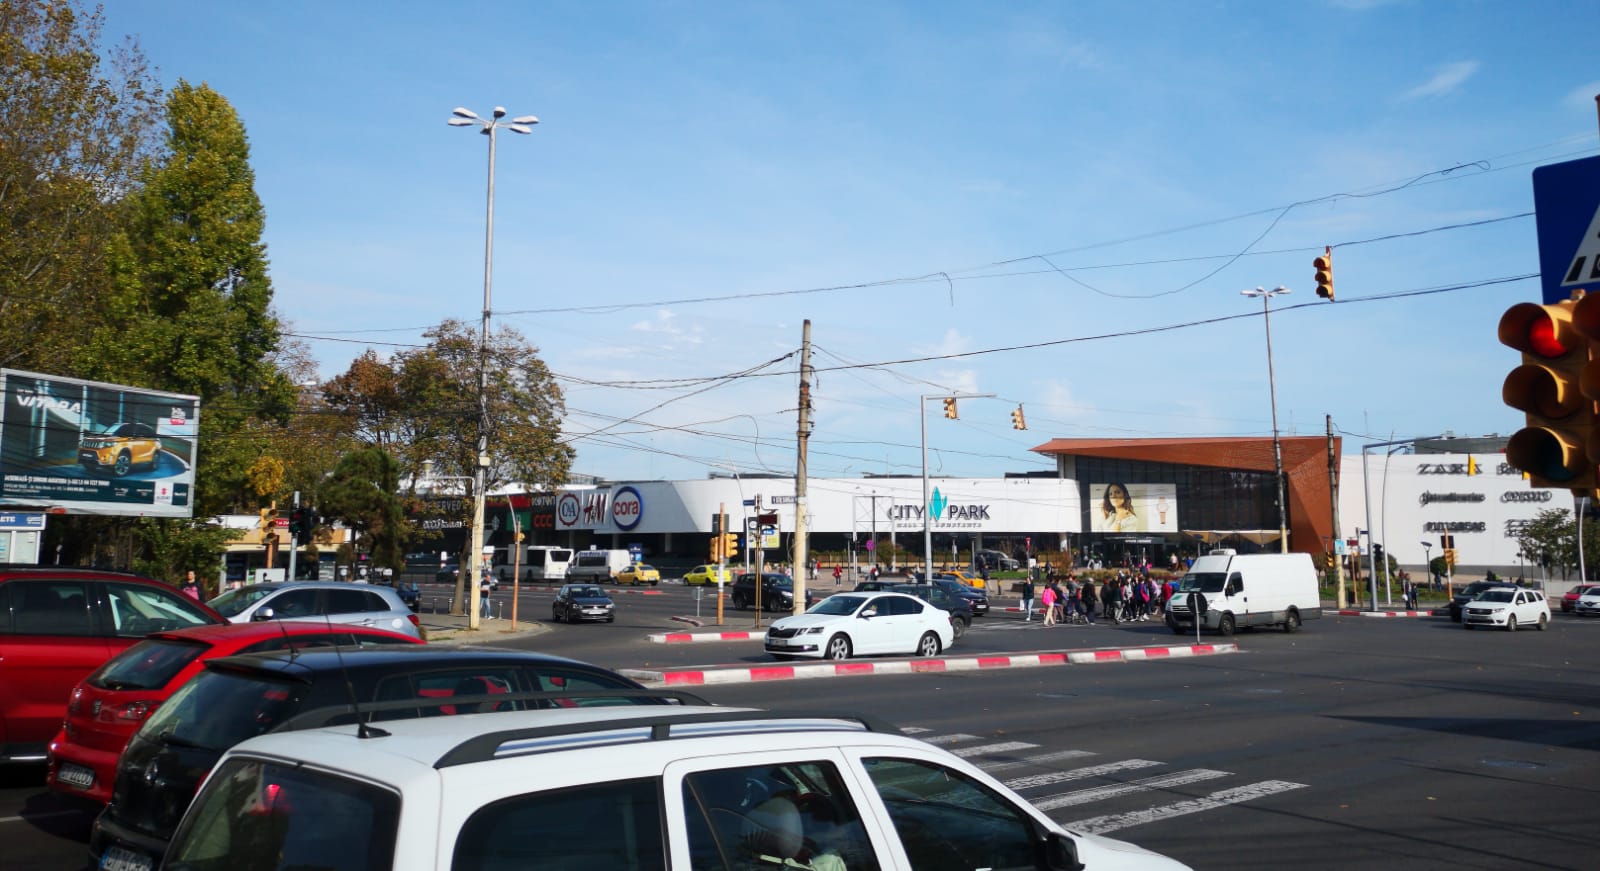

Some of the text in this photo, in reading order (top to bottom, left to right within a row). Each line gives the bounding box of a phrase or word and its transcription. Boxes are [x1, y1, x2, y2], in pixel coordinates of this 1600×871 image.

[584, 493, 609, 525] H&M
[613, 500, 639, 516] cora
[887, 504, 991, 521] CITY PARK
[533, 514, 553, 527] CCC
